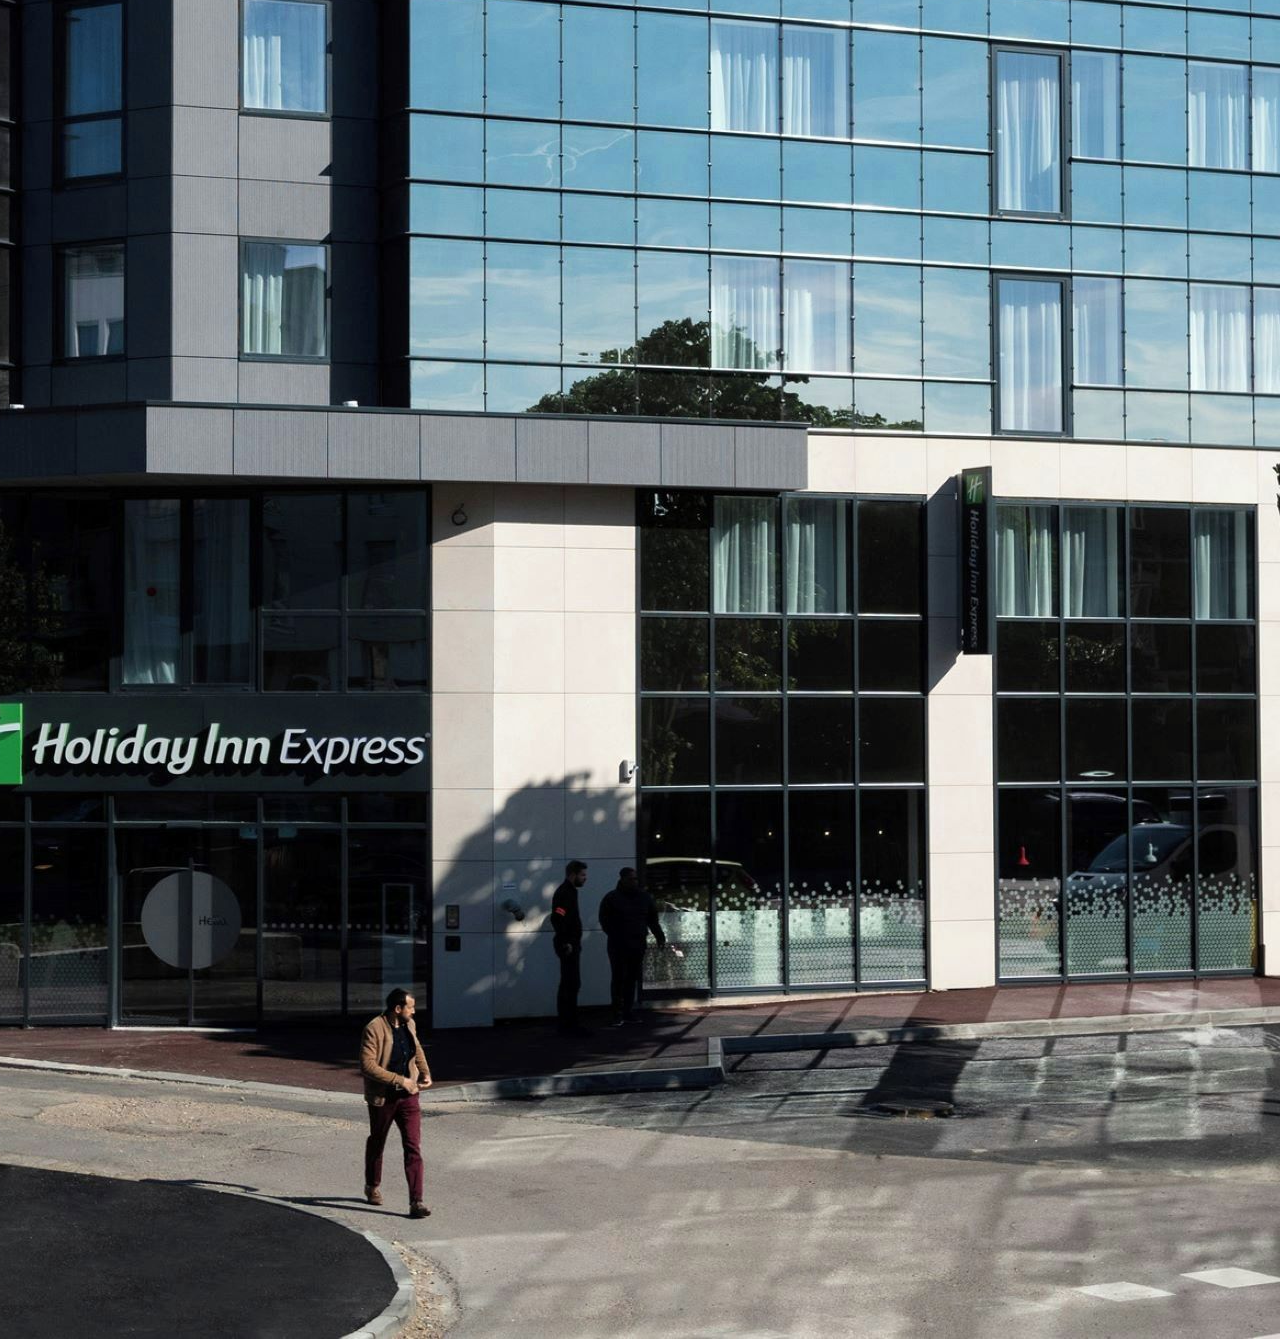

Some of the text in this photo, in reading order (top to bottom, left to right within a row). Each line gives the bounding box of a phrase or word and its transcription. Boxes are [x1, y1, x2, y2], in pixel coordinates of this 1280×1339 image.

[968, 509, 979, 648] Holiday Inn Express
[31, 722, 426, 775] Holiday Inn Express
